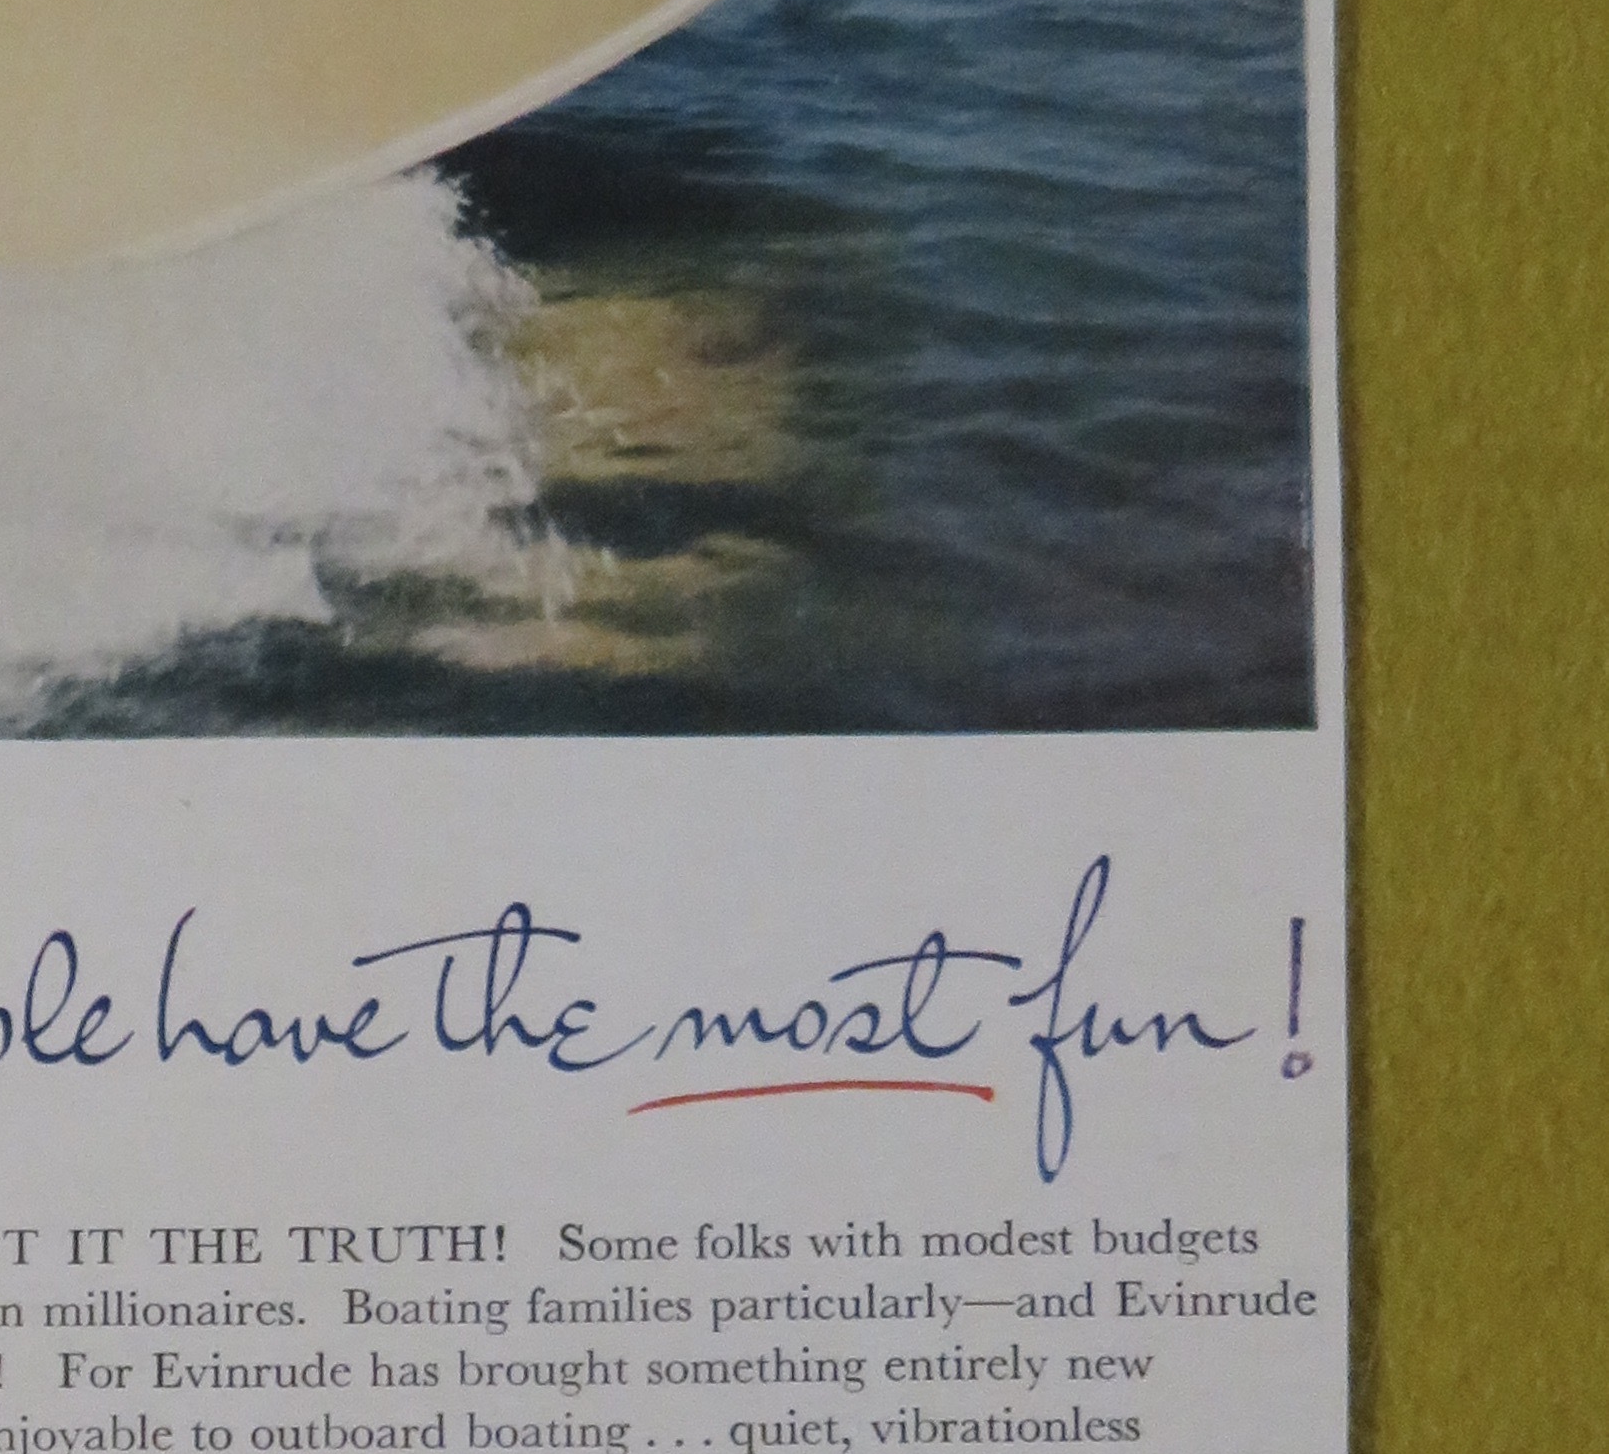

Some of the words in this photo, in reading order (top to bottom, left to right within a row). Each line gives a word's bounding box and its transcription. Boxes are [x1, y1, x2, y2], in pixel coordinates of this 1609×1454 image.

[157, 908, 409, 1066] have
[352, 902, 655, 1072] the
[655, 931, 1022, 1060] most
[68, 1228, 124, 1265] IT
[150, 1228, 262, 1264] THE
[288, 1224, 505, 1263] TRUTH!
[559, 1223, 678, 1261] Some
[696, 1222, 791, 1259] folks
[808, 1221, 902, 1257] with
[922, 1219, 1072, 1257] modest
[1092, 1218, 1259, 1265] budgets
[58, 1352, 133, 1389] For
[153, 1351, 351, 1388] Evinrude
[370, 1351, 439, 1387] has
[459, 1349, 628, 1396] brought
[647, 1346, 867, 1393] something
[885, 1343, 1048, 1391] entirely
[1067, 1356, 1154, 1380] new
